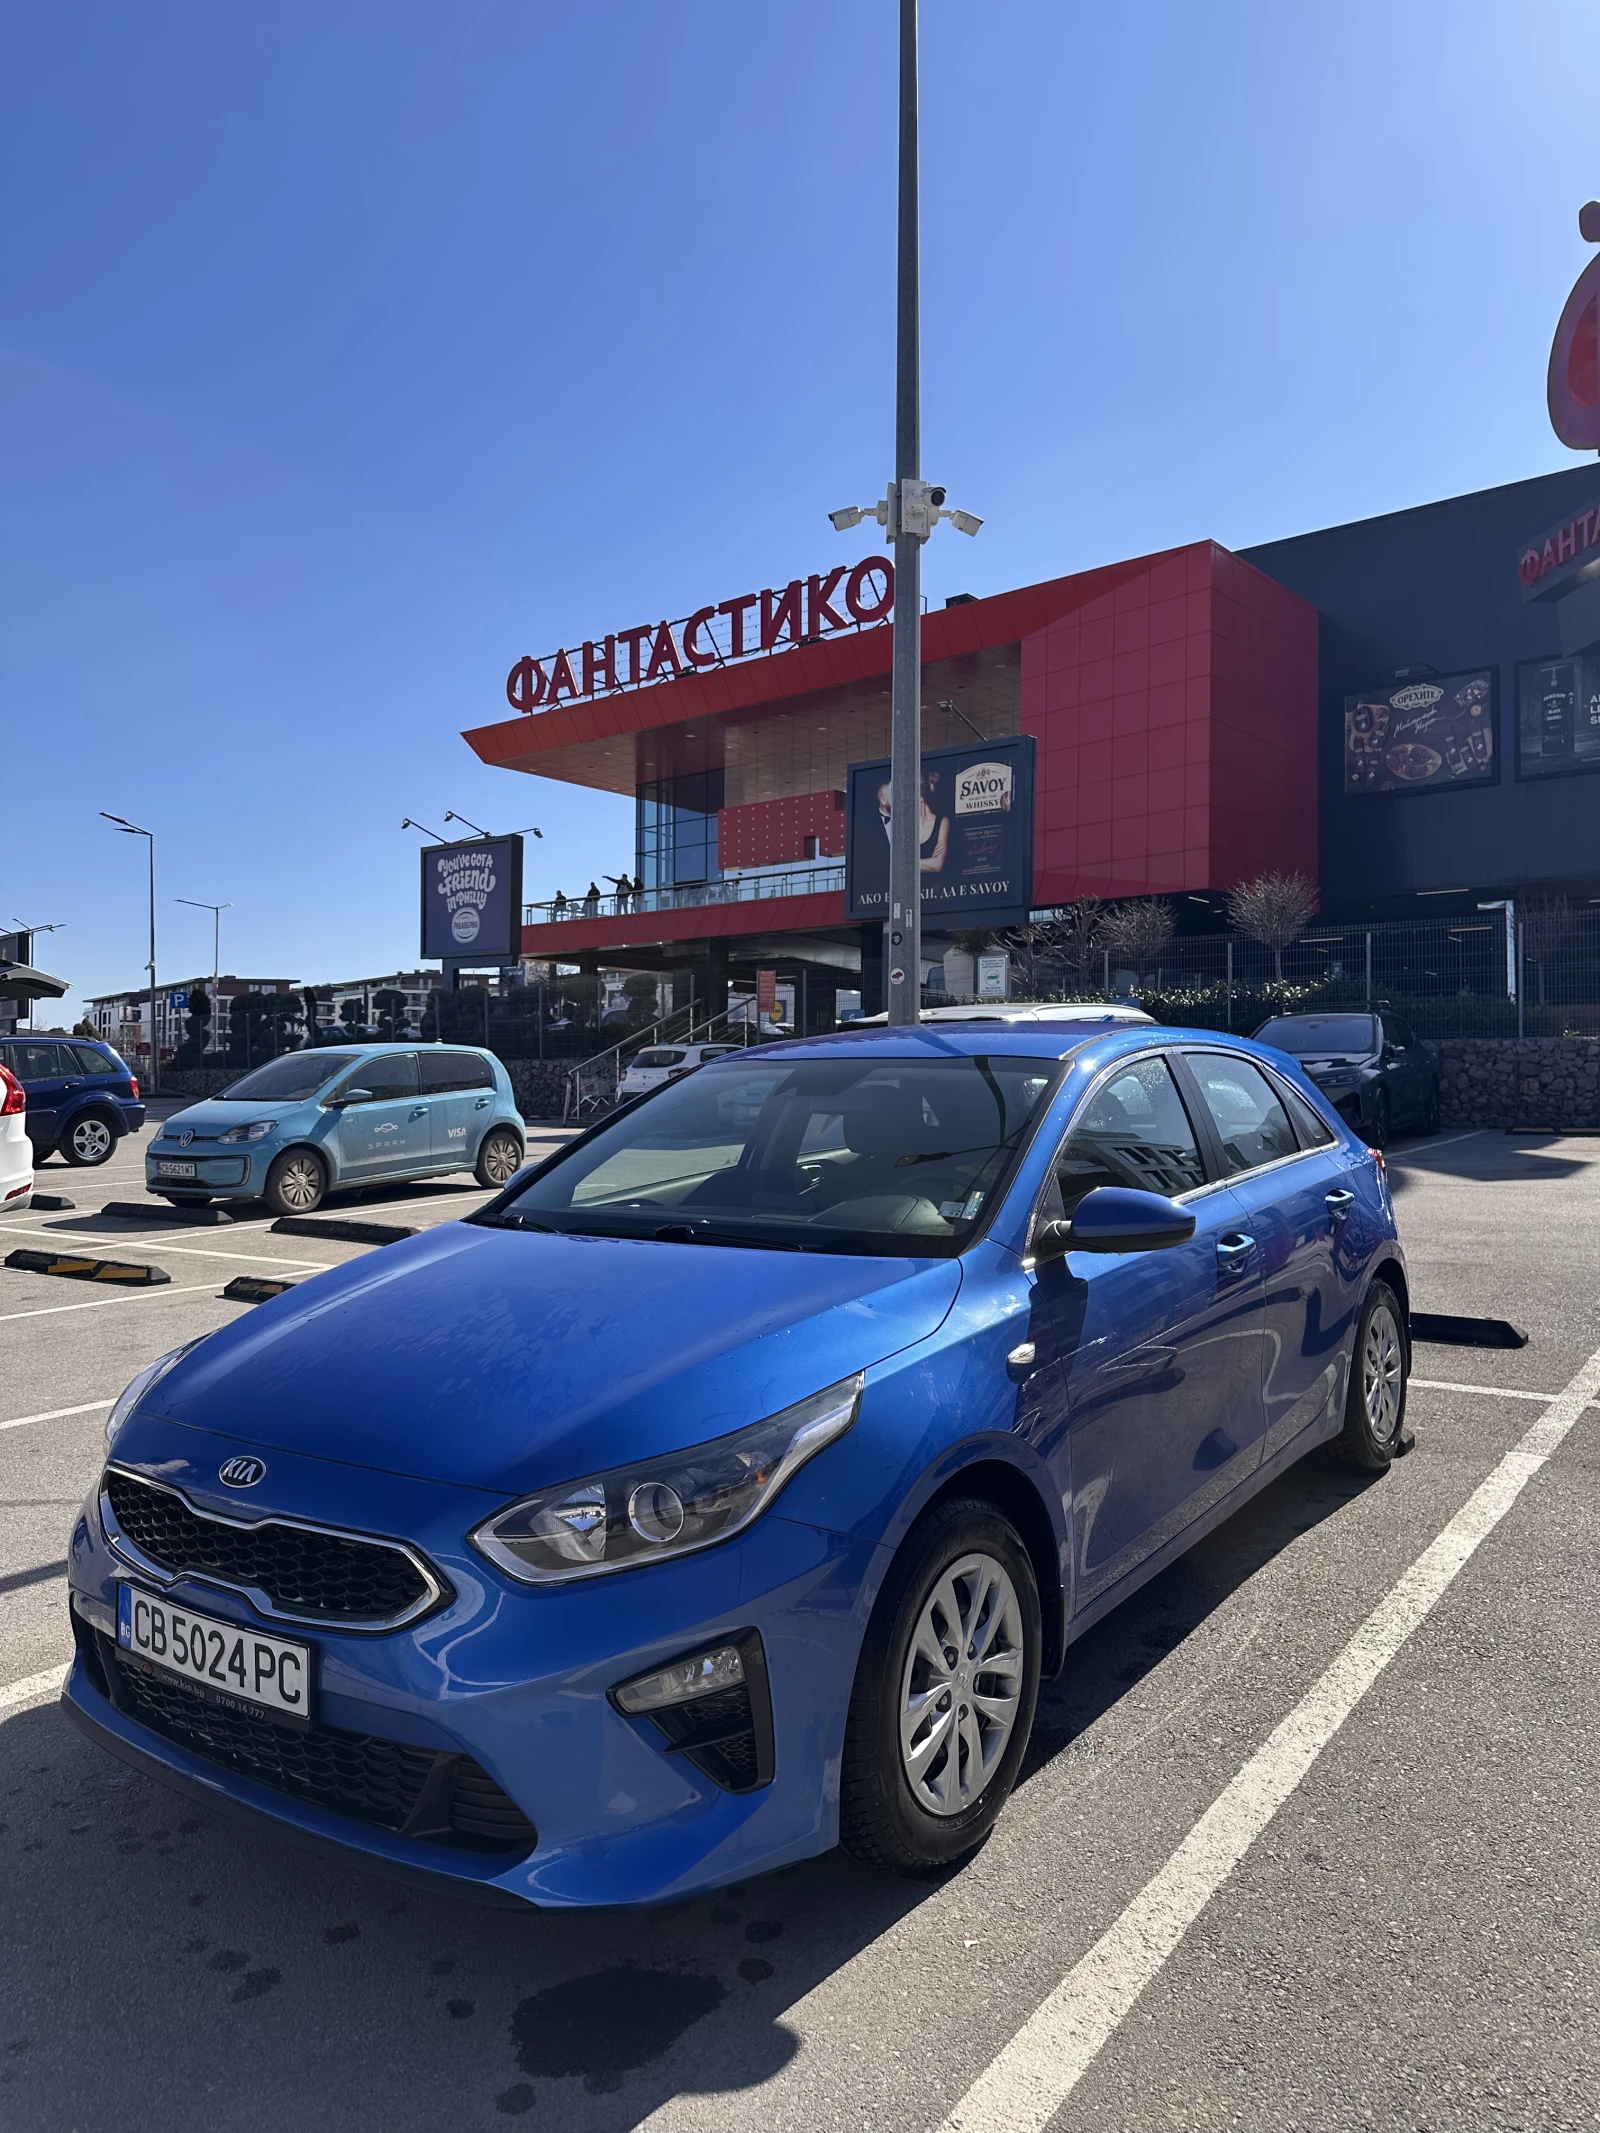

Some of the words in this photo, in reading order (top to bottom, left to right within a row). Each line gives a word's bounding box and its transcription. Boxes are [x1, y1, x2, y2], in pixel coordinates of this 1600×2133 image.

[506, 555, 896, 714] ФАНТАСТИКО
[1397, 690, 1436, 705] ОРЕХИТЕ
[1543, 693, 1566, 702] JAMESON
[960, 777, 1006, 800] SAVOY
[965, 799, 1000, 810] WHISKY
[858, 892, 882, 905] АКО
[939, 886, 957, 900] ДА
[959, 885, 967, 896] Е
[969, 880, 1010, 896] SAVOY
[174, 993, 184, 1007] P
[447, 1127, 467, 1138] VISA
[367, 1139, 407, 1150] SPARK
[222, 1459, 257, 1483] KIA
[120, 1621, 131, 1639] BG
[161, 1672, 206, 1699] www.kia.bg
[215, 1694, 236, 1710] 0700
[237, 1702, 248, 1713] 14
[249, 1706, 265, 1720] 777
